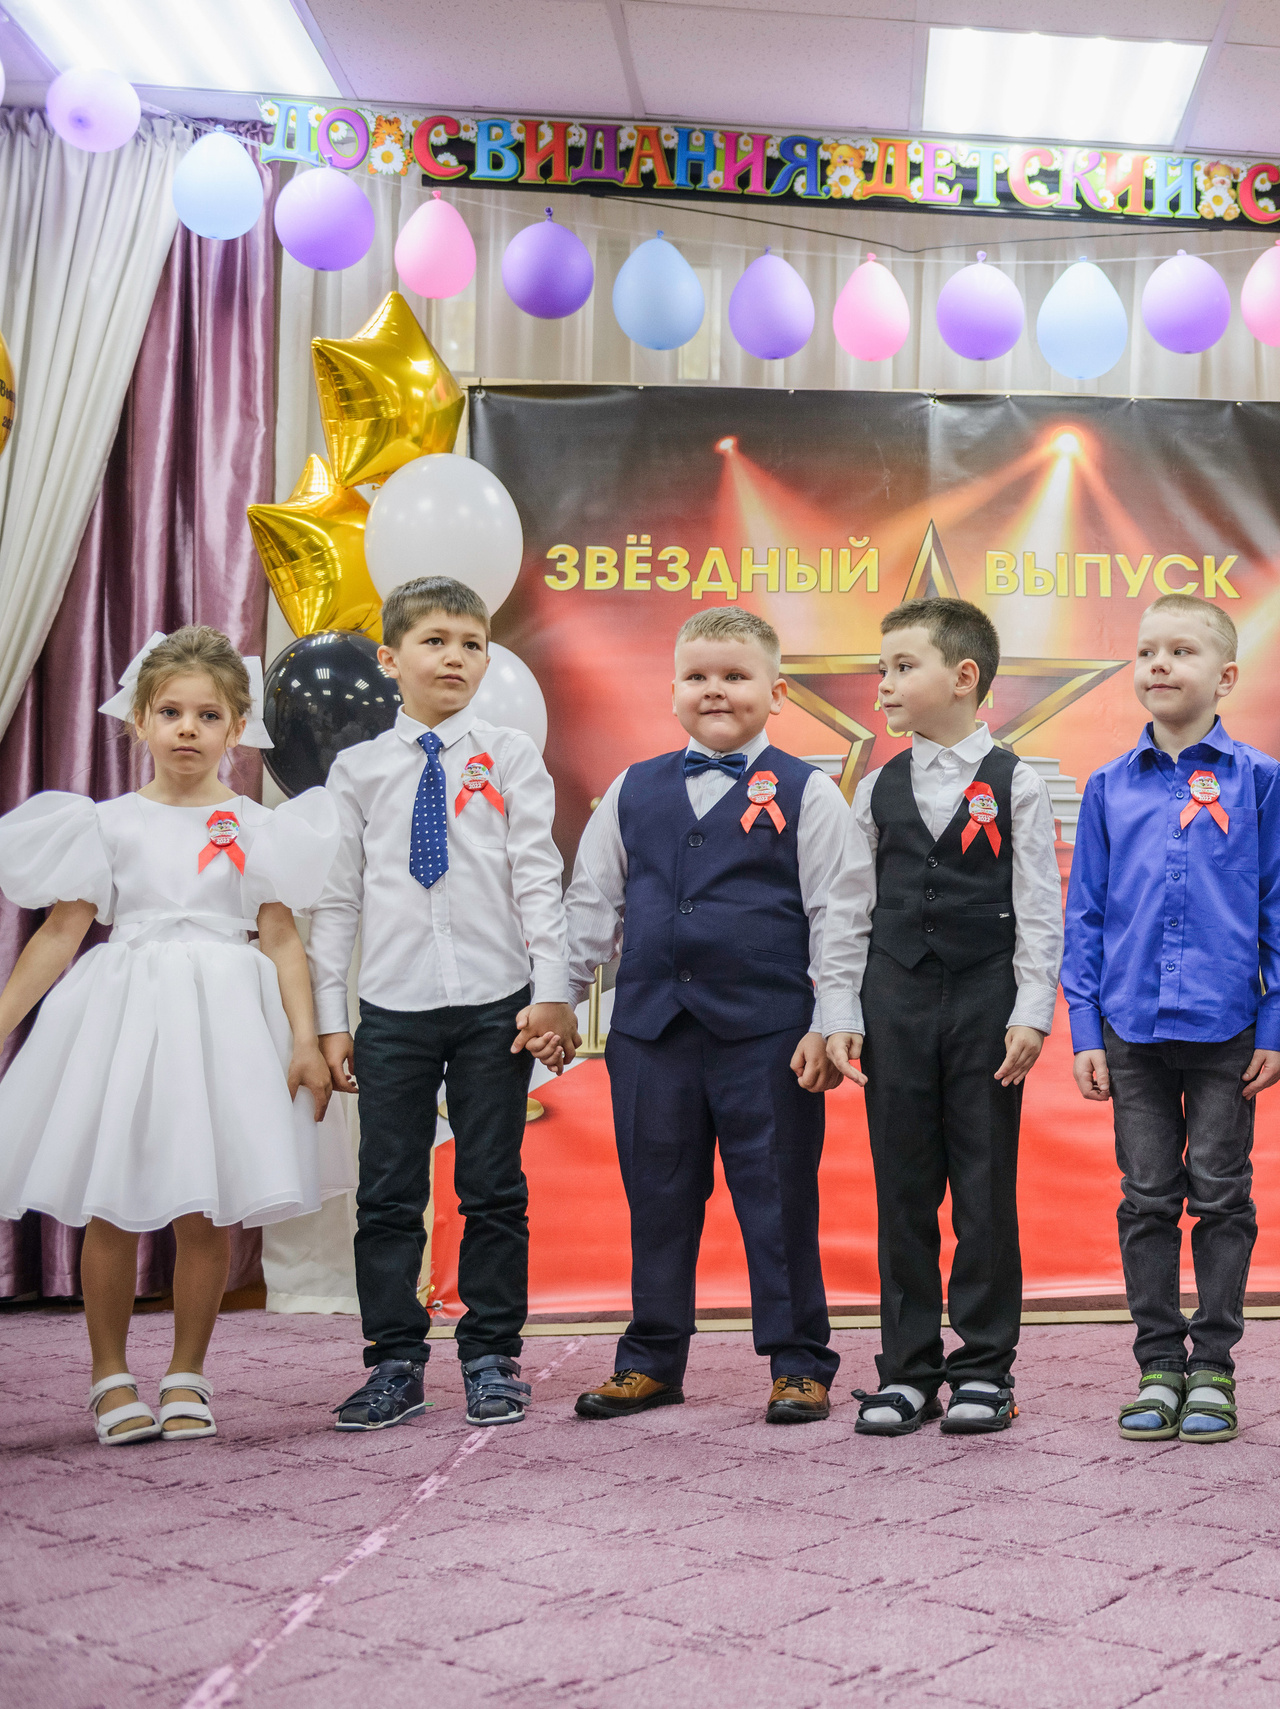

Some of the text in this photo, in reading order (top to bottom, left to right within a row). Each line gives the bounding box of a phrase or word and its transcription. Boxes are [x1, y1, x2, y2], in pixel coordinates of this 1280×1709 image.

[259, 98, 371, 172] ДО
[863, 138, 1201, 220] ДЕТСКИЙ
[544, 533, 1242, 600] ЗВЁЗДНЫЙ ВЫПУСК
